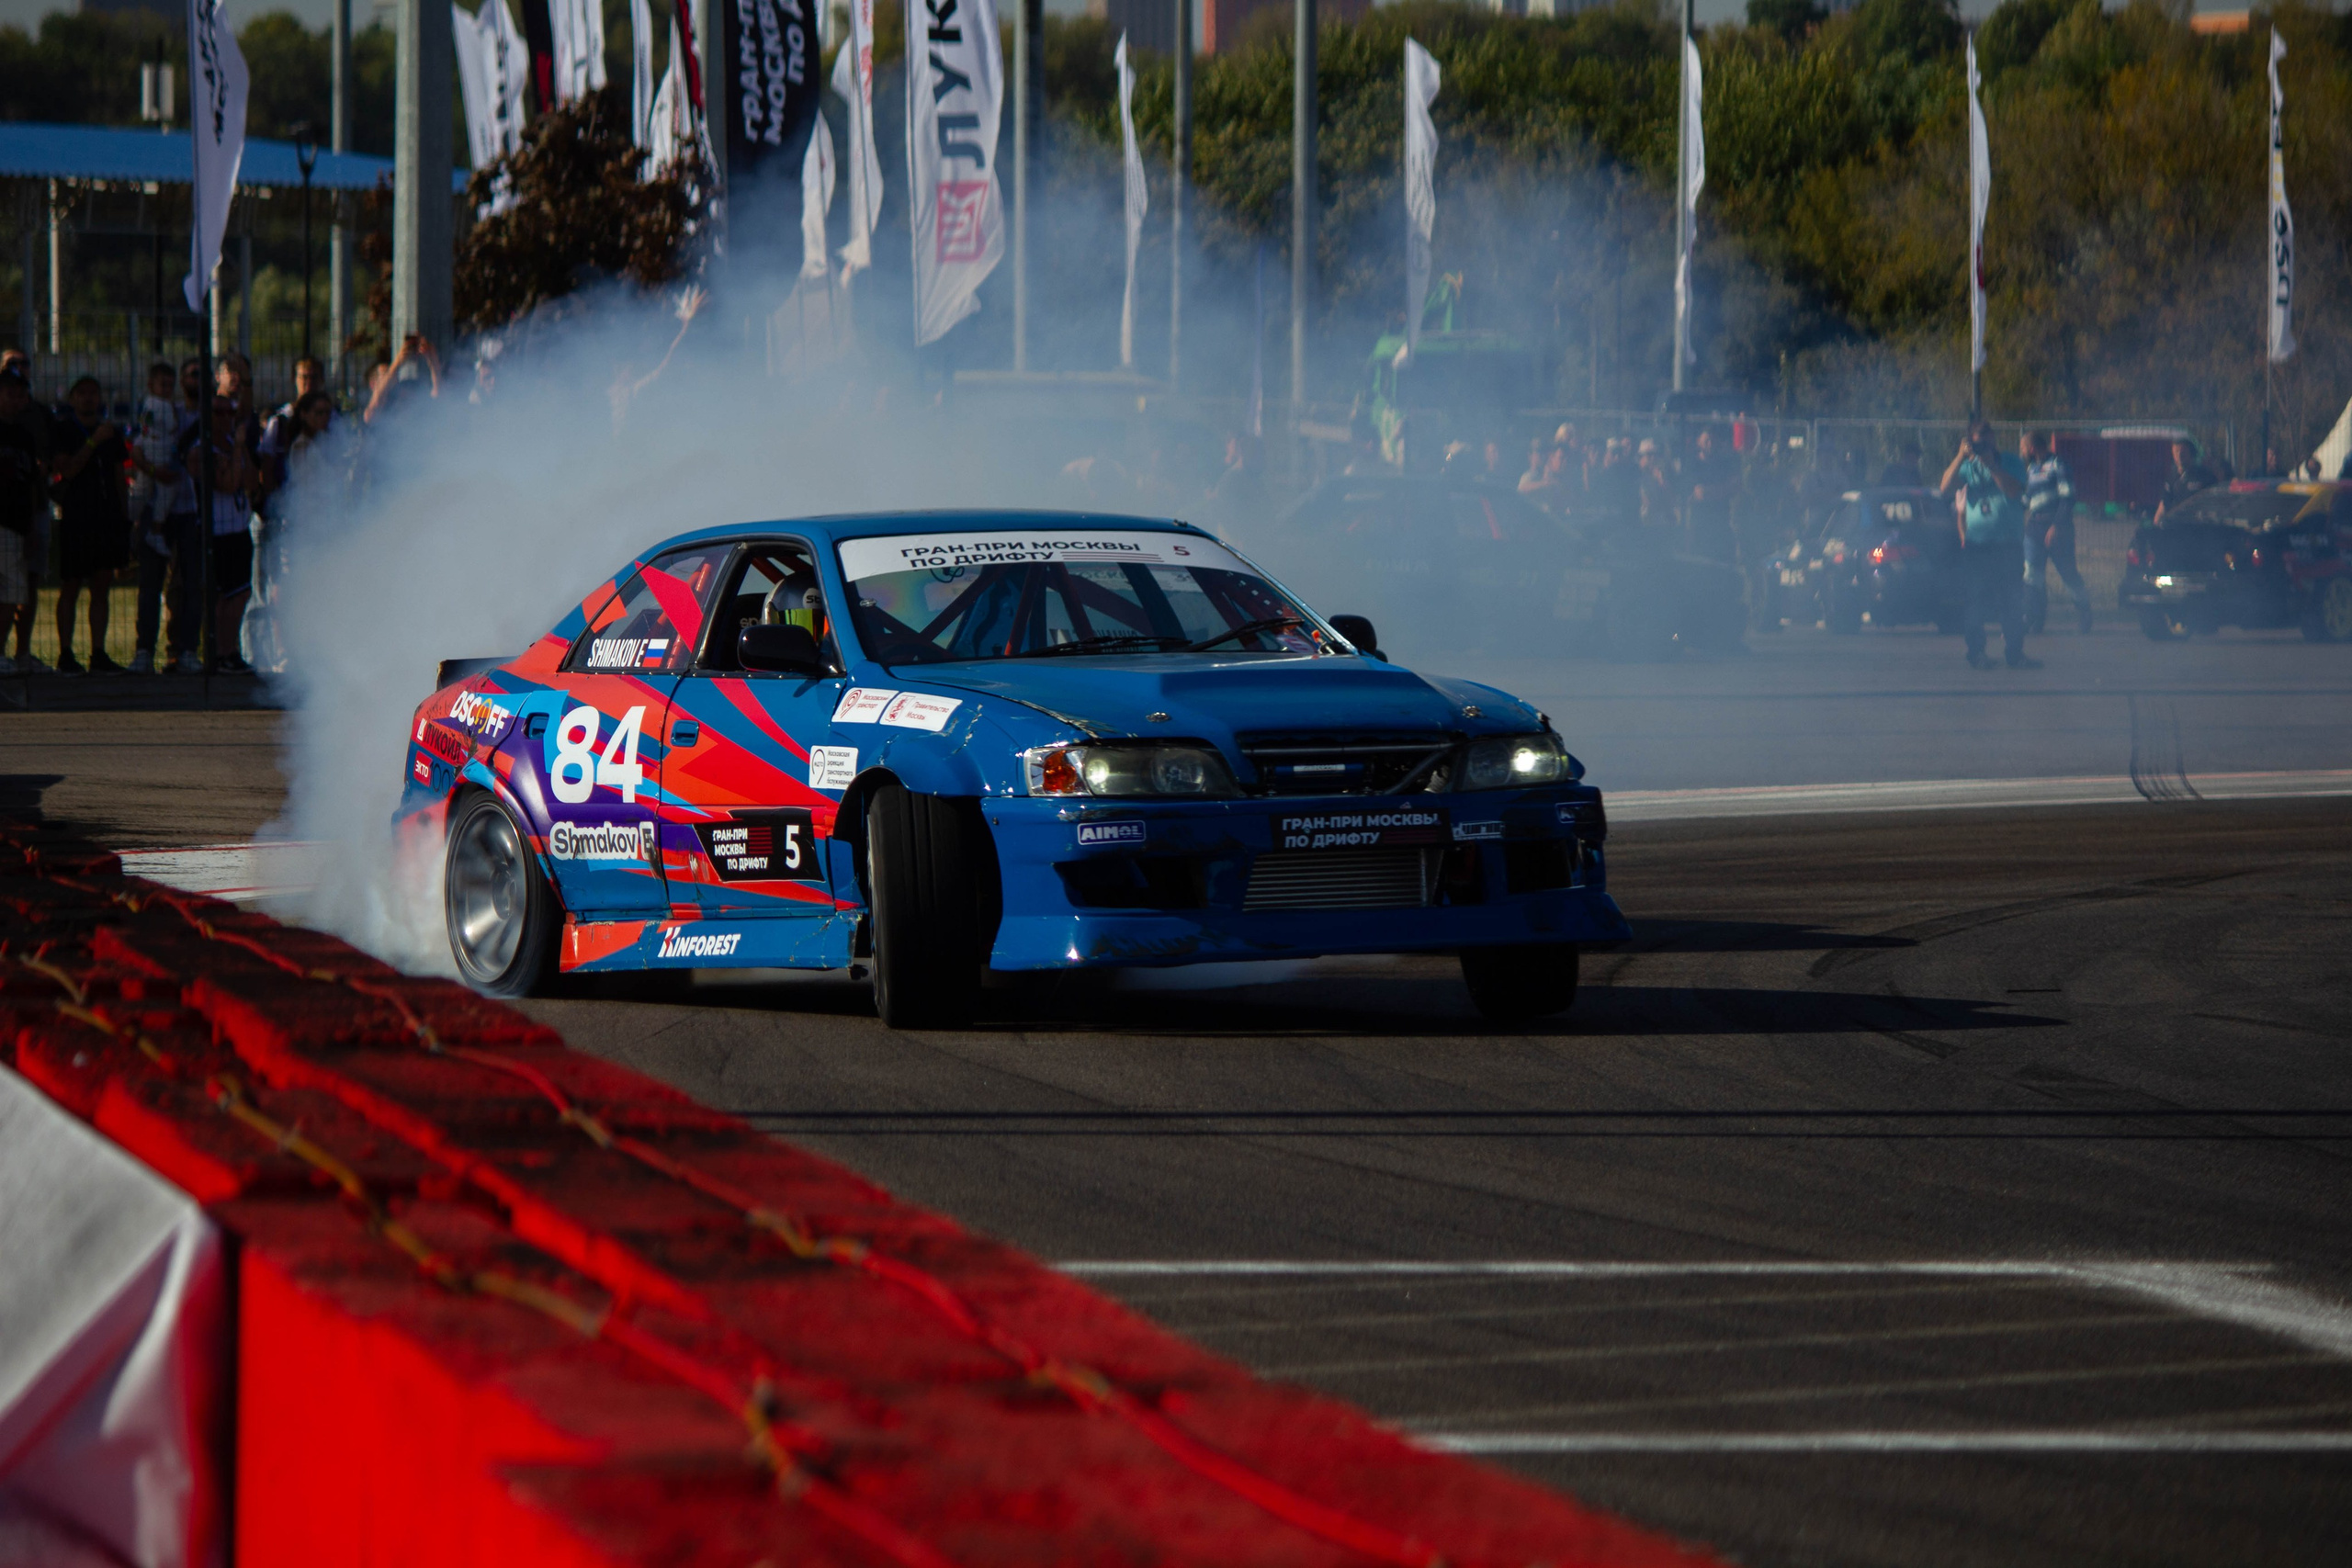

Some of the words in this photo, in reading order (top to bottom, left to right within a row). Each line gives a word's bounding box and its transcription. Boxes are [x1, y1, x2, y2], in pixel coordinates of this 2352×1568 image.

[900, 540, 1024, 558] ГРАН-ПРИ
[1032, 540, 1141, 551] МОСКВЫ
[1173, 546, 1192, 557] 5
[910, 557, 950, 569] ПО
[954, 550, 1055, 567] ДРИФТУ
[587, 638, 640, 667] SHMAKOV
[634, 638, 648, 667] E
[424, 722, 462, 762] ЛУКОЙЛ
[550, 705, 647, 804] 84
[414, 760, 430, 778] ЭКТО
[1282, 815, 1363, 830] ГРАН-ПРИ
[1366, 813, 1439, 827] МОСКВЫ
[554, 828, 637, 854] Shmakov
[712, 828, 749, 841] ГРАН-ПРИ
[1080, 825, 1143, 841] AIMOL
[1284, 835, 1309, 848] ПО
[1312, 832, 1381, 849] ДРИФТУ
[714, 842, 746, 856] МОСКВЫ
[785, 825, 801, 869] 5
[727, 858, 738, 870] ПО
[739, 856, 769, 871] ДРИФТУ
[657, 926, 741, 958] KINFOREST
